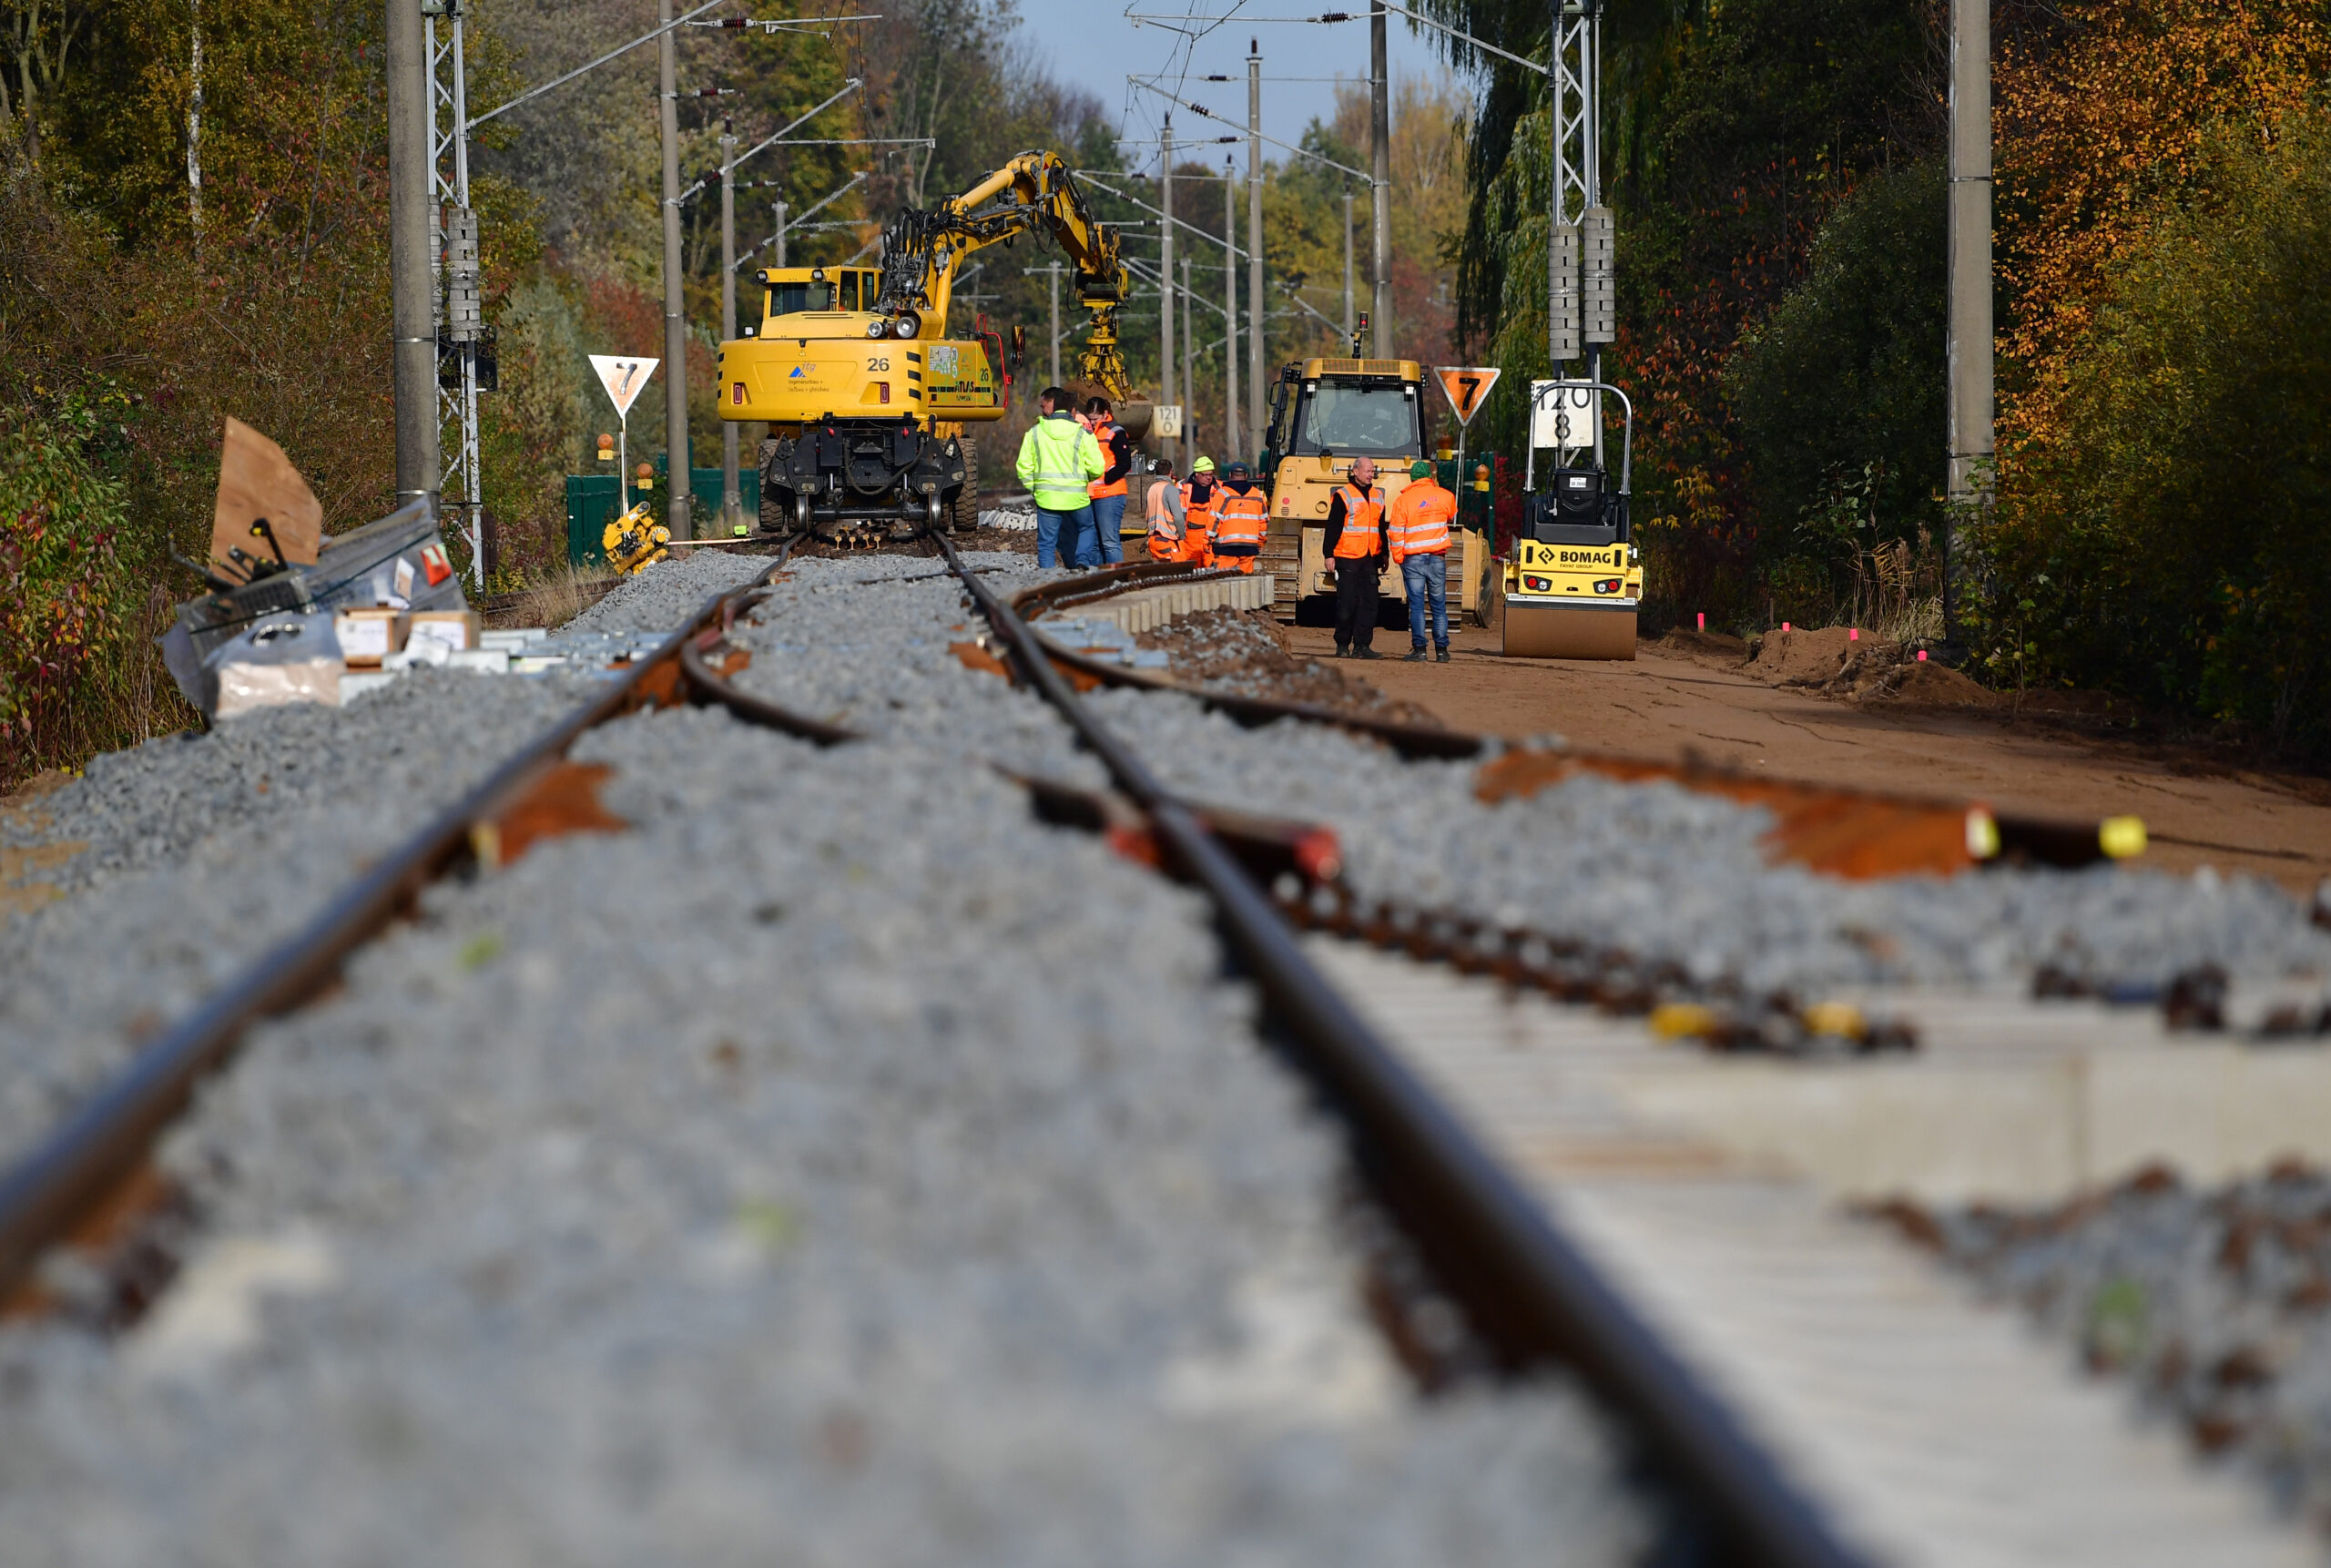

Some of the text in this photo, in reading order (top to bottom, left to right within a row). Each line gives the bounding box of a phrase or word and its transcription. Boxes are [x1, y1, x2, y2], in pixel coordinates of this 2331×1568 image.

[867, 357, 891, 372] 26
[616, 362, 638, 395] 7
[980, 368, 989, 382] 26
[954, 381, 974, 392] ATLAS
[1459, 377, 1481, 410] 7
[1159, 407, 1176, 420] 121
[1163, 422, 1173, 433] 0
[1554, 413, 1571, 440] 8
[1560, 551, 1611, 564] BOMAG
